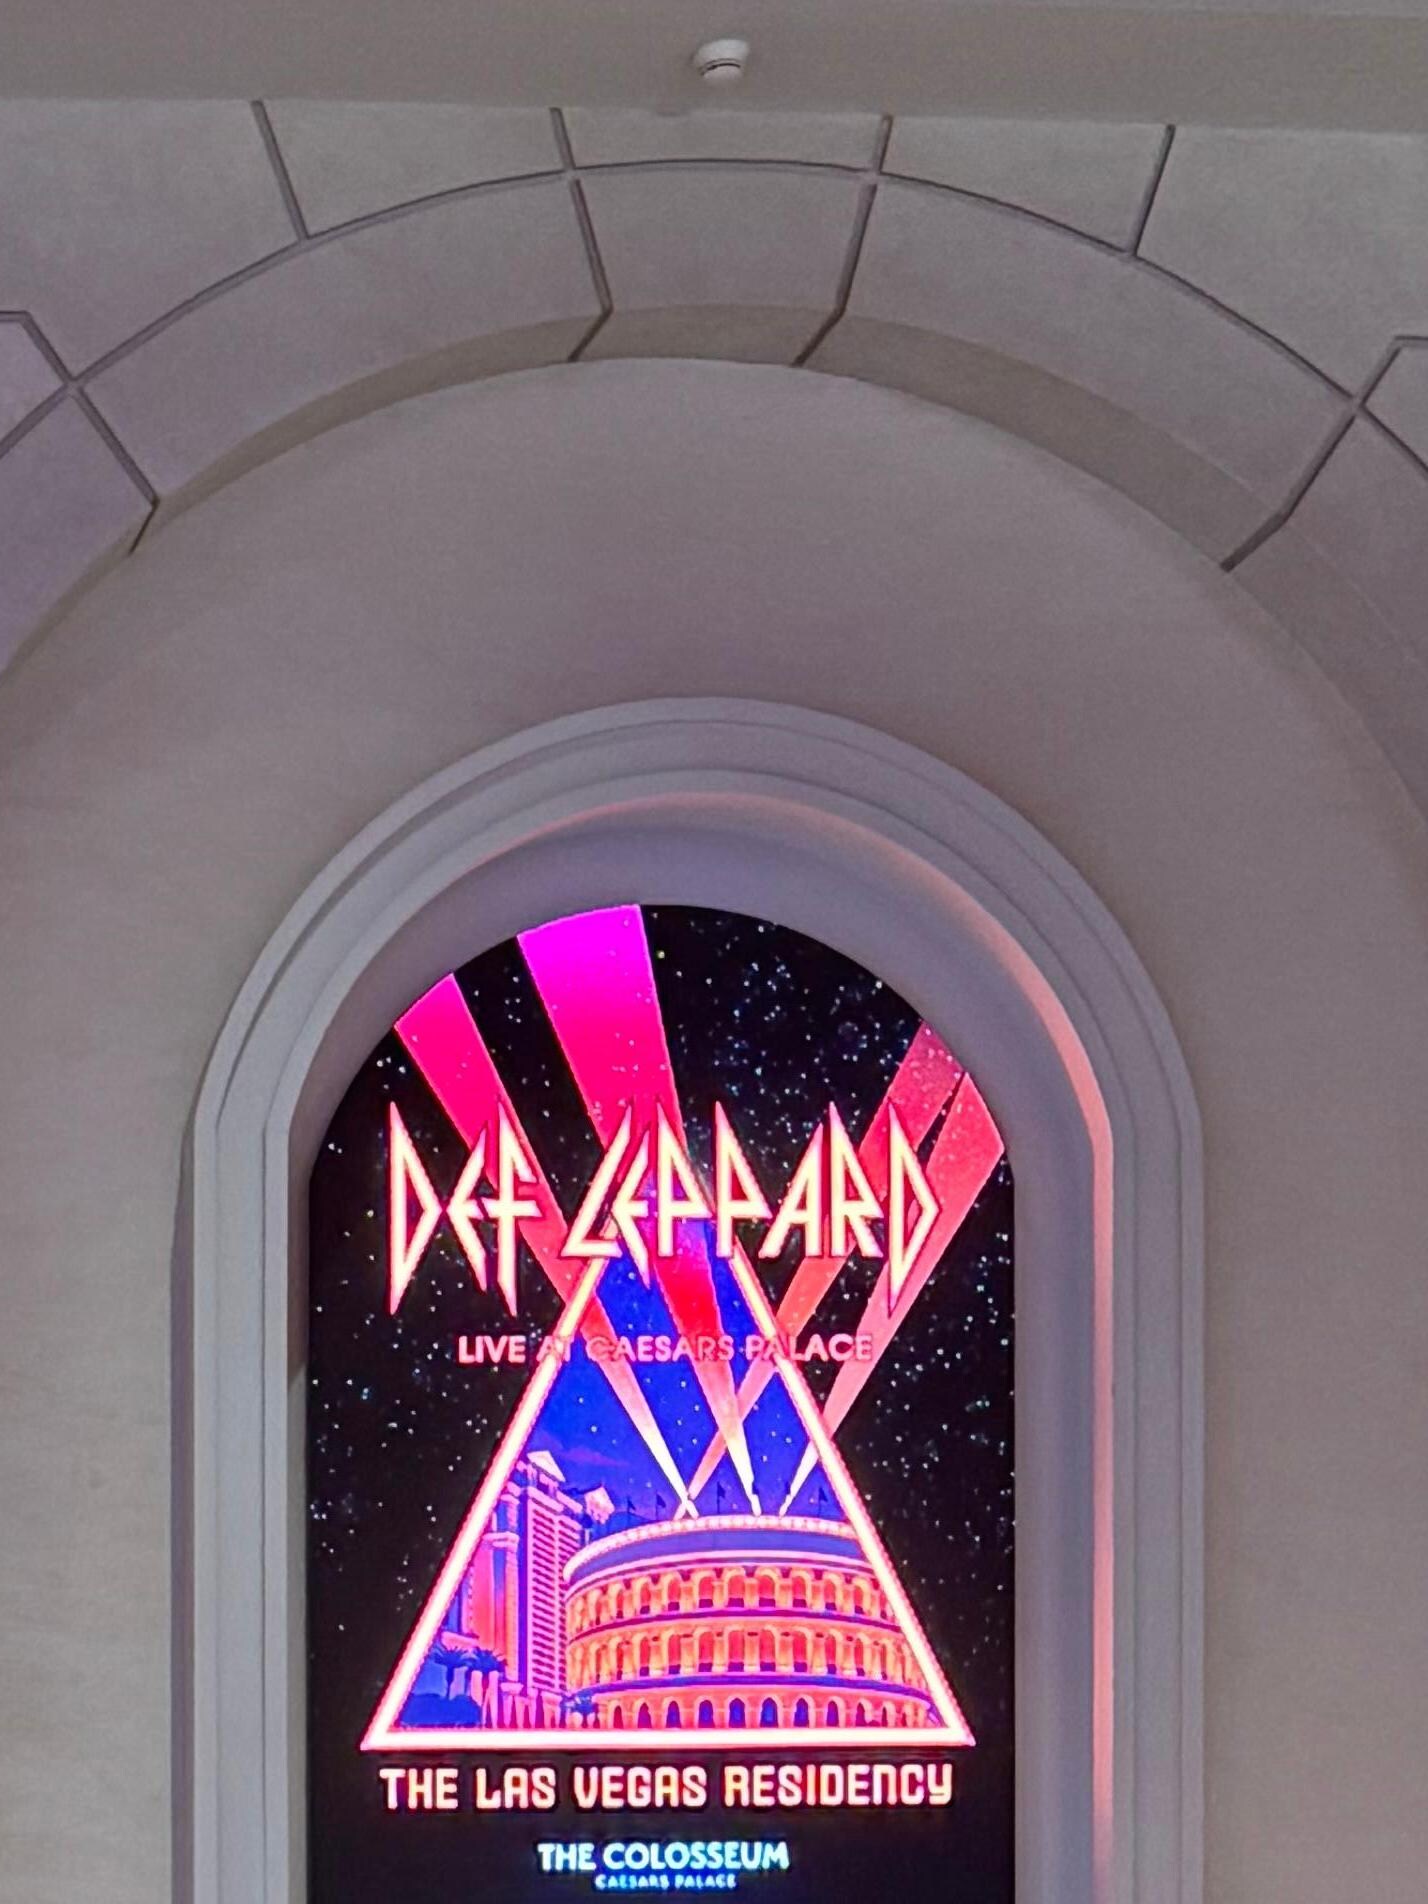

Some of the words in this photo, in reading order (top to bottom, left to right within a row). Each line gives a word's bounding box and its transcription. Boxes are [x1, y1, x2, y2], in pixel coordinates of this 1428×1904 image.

[388, 1100, 543, 1316] DEF
[559, 1100, 940, 1318] LEPPARD
[459, 1336, 526, 1364] LIVE
[536, 1335, 573, 1362] AT
[585, 1335, 734, 1362] CAESARS
[746, 1333, 873, 1360] PALACE
[379, 1768, 459, 1809] THE
[475, 1768, 556, 1808] LAS
[573, 1766, 707, 1807] VEGAS
[724, 1763, 954, 1805] RESIDENCY
[537, 1843, 596, 1870] THE
[603, 1842, 790, 1869] COLOSSEUM
[595, 1874, 669, 1889] CAESARS
[676, 1874, 737, 1888] PALACE
